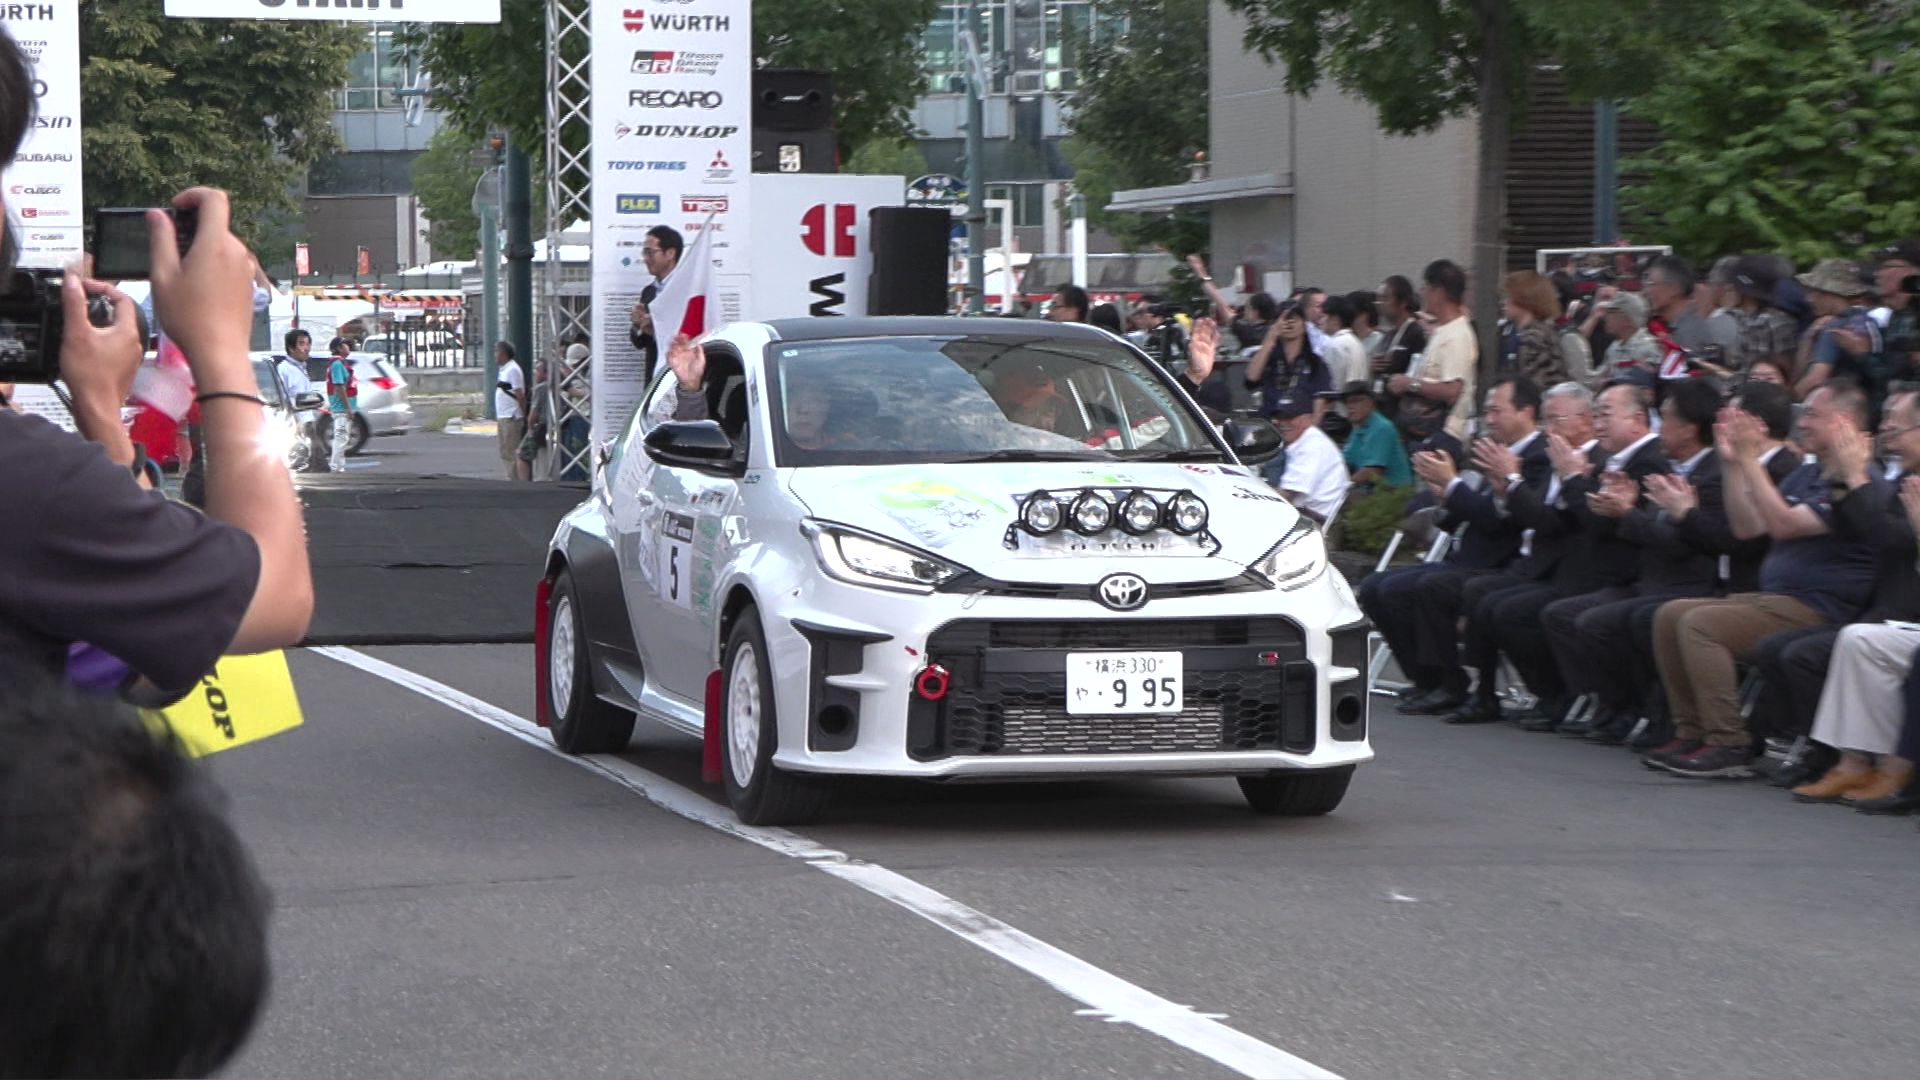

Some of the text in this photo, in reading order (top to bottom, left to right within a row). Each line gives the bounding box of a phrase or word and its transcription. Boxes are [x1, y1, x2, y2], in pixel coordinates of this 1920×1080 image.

[650, 14, 730, 31] WÜRTH
[629, 89, 723, 108] RECARO
[634, 124, 739, 139] DUNLOP
[607, 161, 688, 170] TOYO TIRES
[620, 197, 657, 211] FLEX
[670, 545, 679, 601] 5
